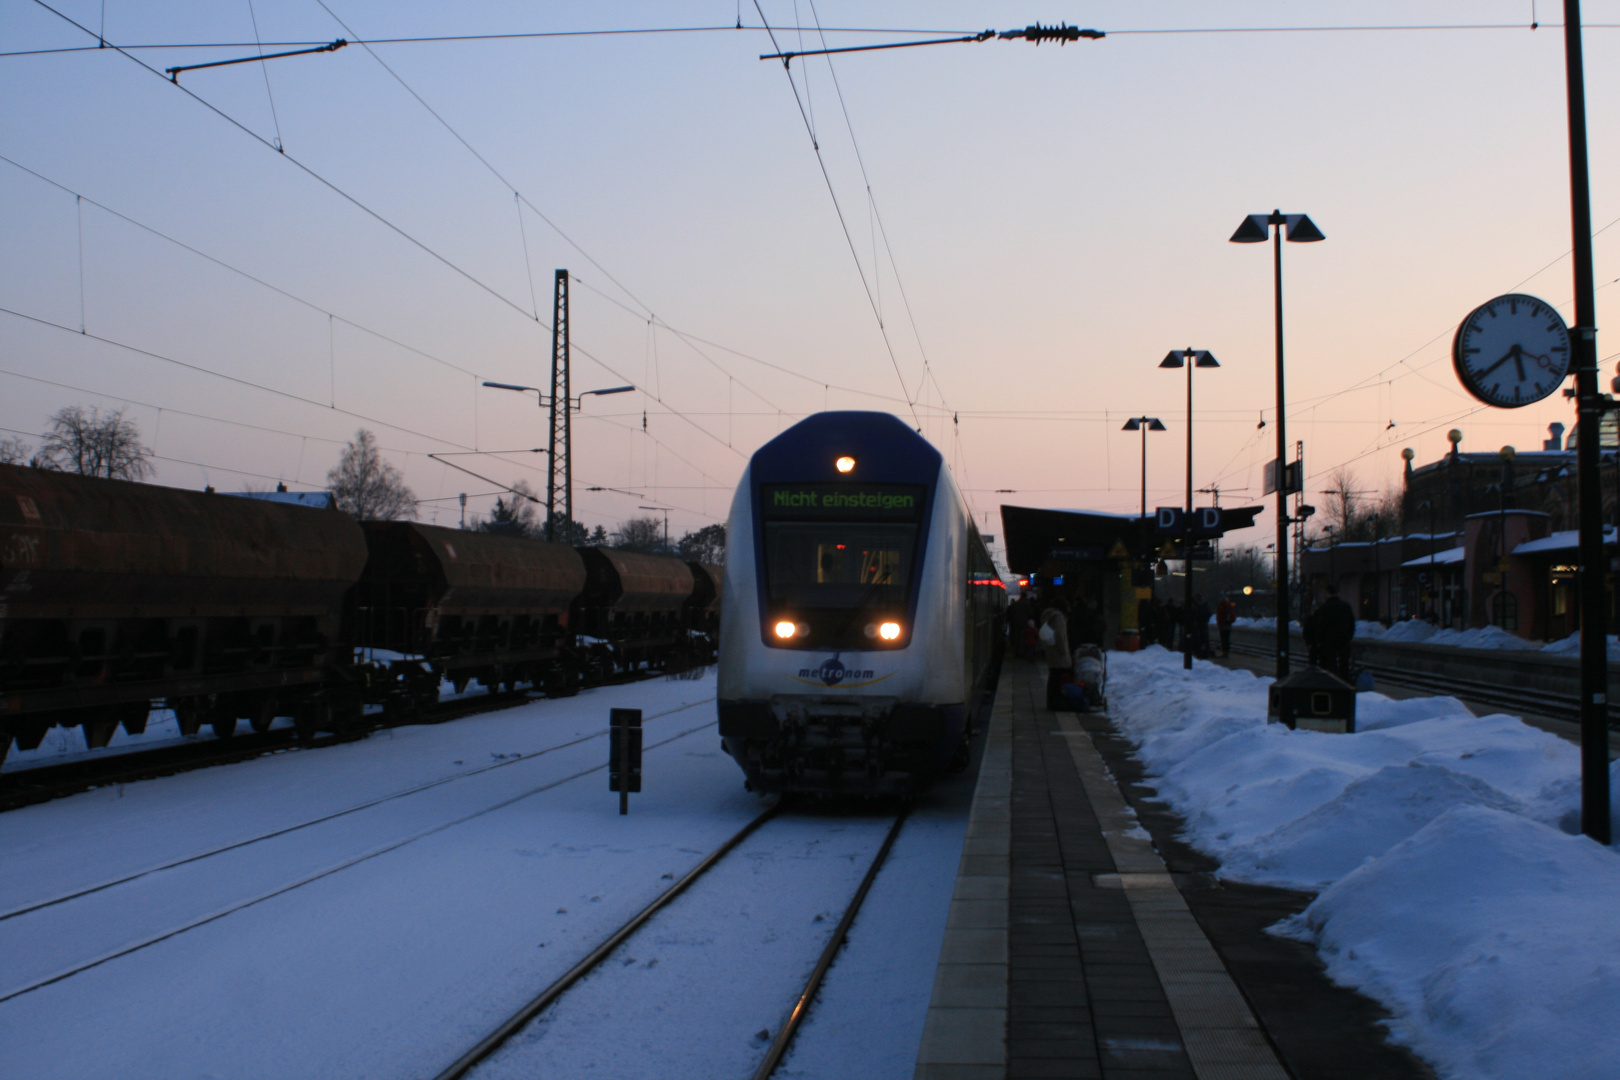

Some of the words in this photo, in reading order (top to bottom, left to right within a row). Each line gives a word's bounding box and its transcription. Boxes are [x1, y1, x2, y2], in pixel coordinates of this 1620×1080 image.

[774, 491, 818, 507] Nicht
[822, 491, 914, 509] einsteigen
[1159, 508, 1175, 528] D
[1203, 508, 1219, 528] D
[799, 667, 874, 679] metronom
